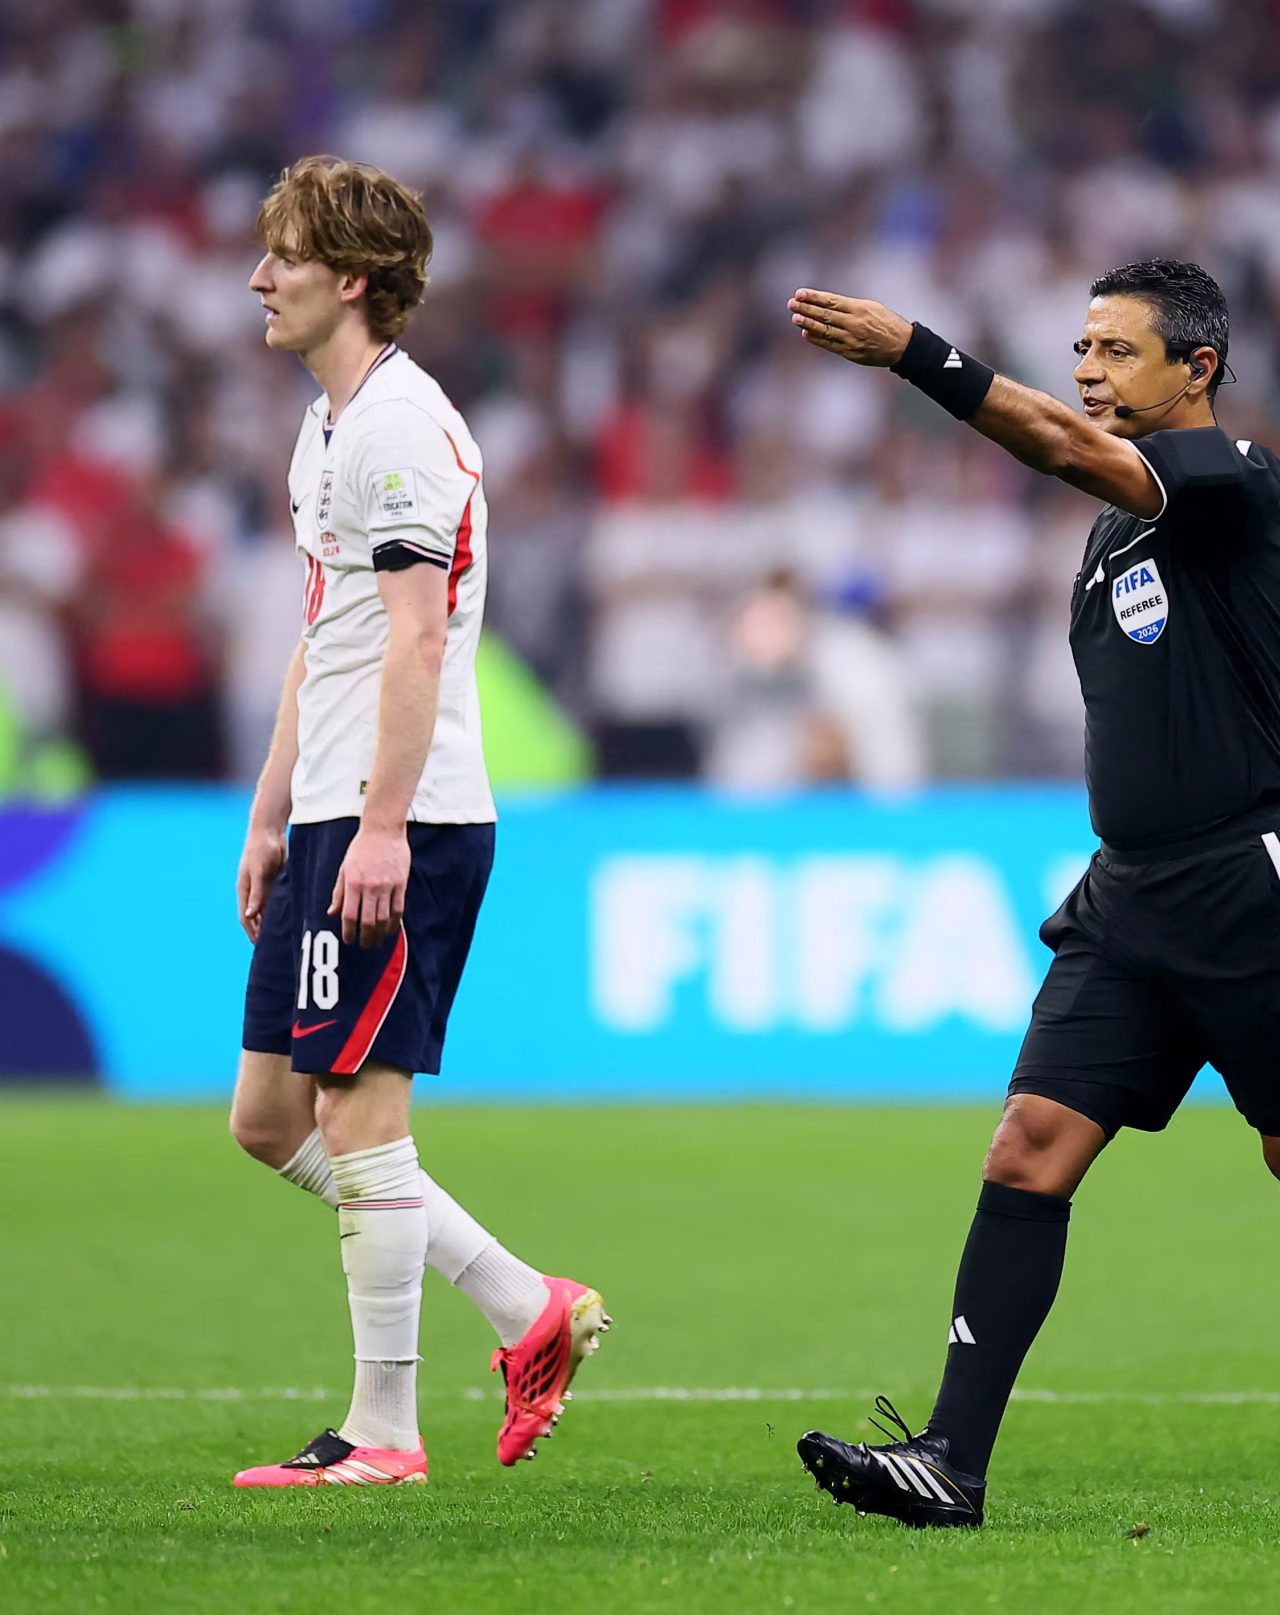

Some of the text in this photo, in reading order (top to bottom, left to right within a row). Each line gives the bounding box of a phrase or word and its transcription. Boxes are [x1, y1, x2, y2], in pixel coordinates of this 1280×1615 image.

[1116, 567, 1155, 598] FIFA
[1120, 595, 1163, 621] REFEREE
[1137, 624, 1159, 639] 2026
[590, 852, 1034, 1033] FIFA
[297, 930, 339, 1010] 18
